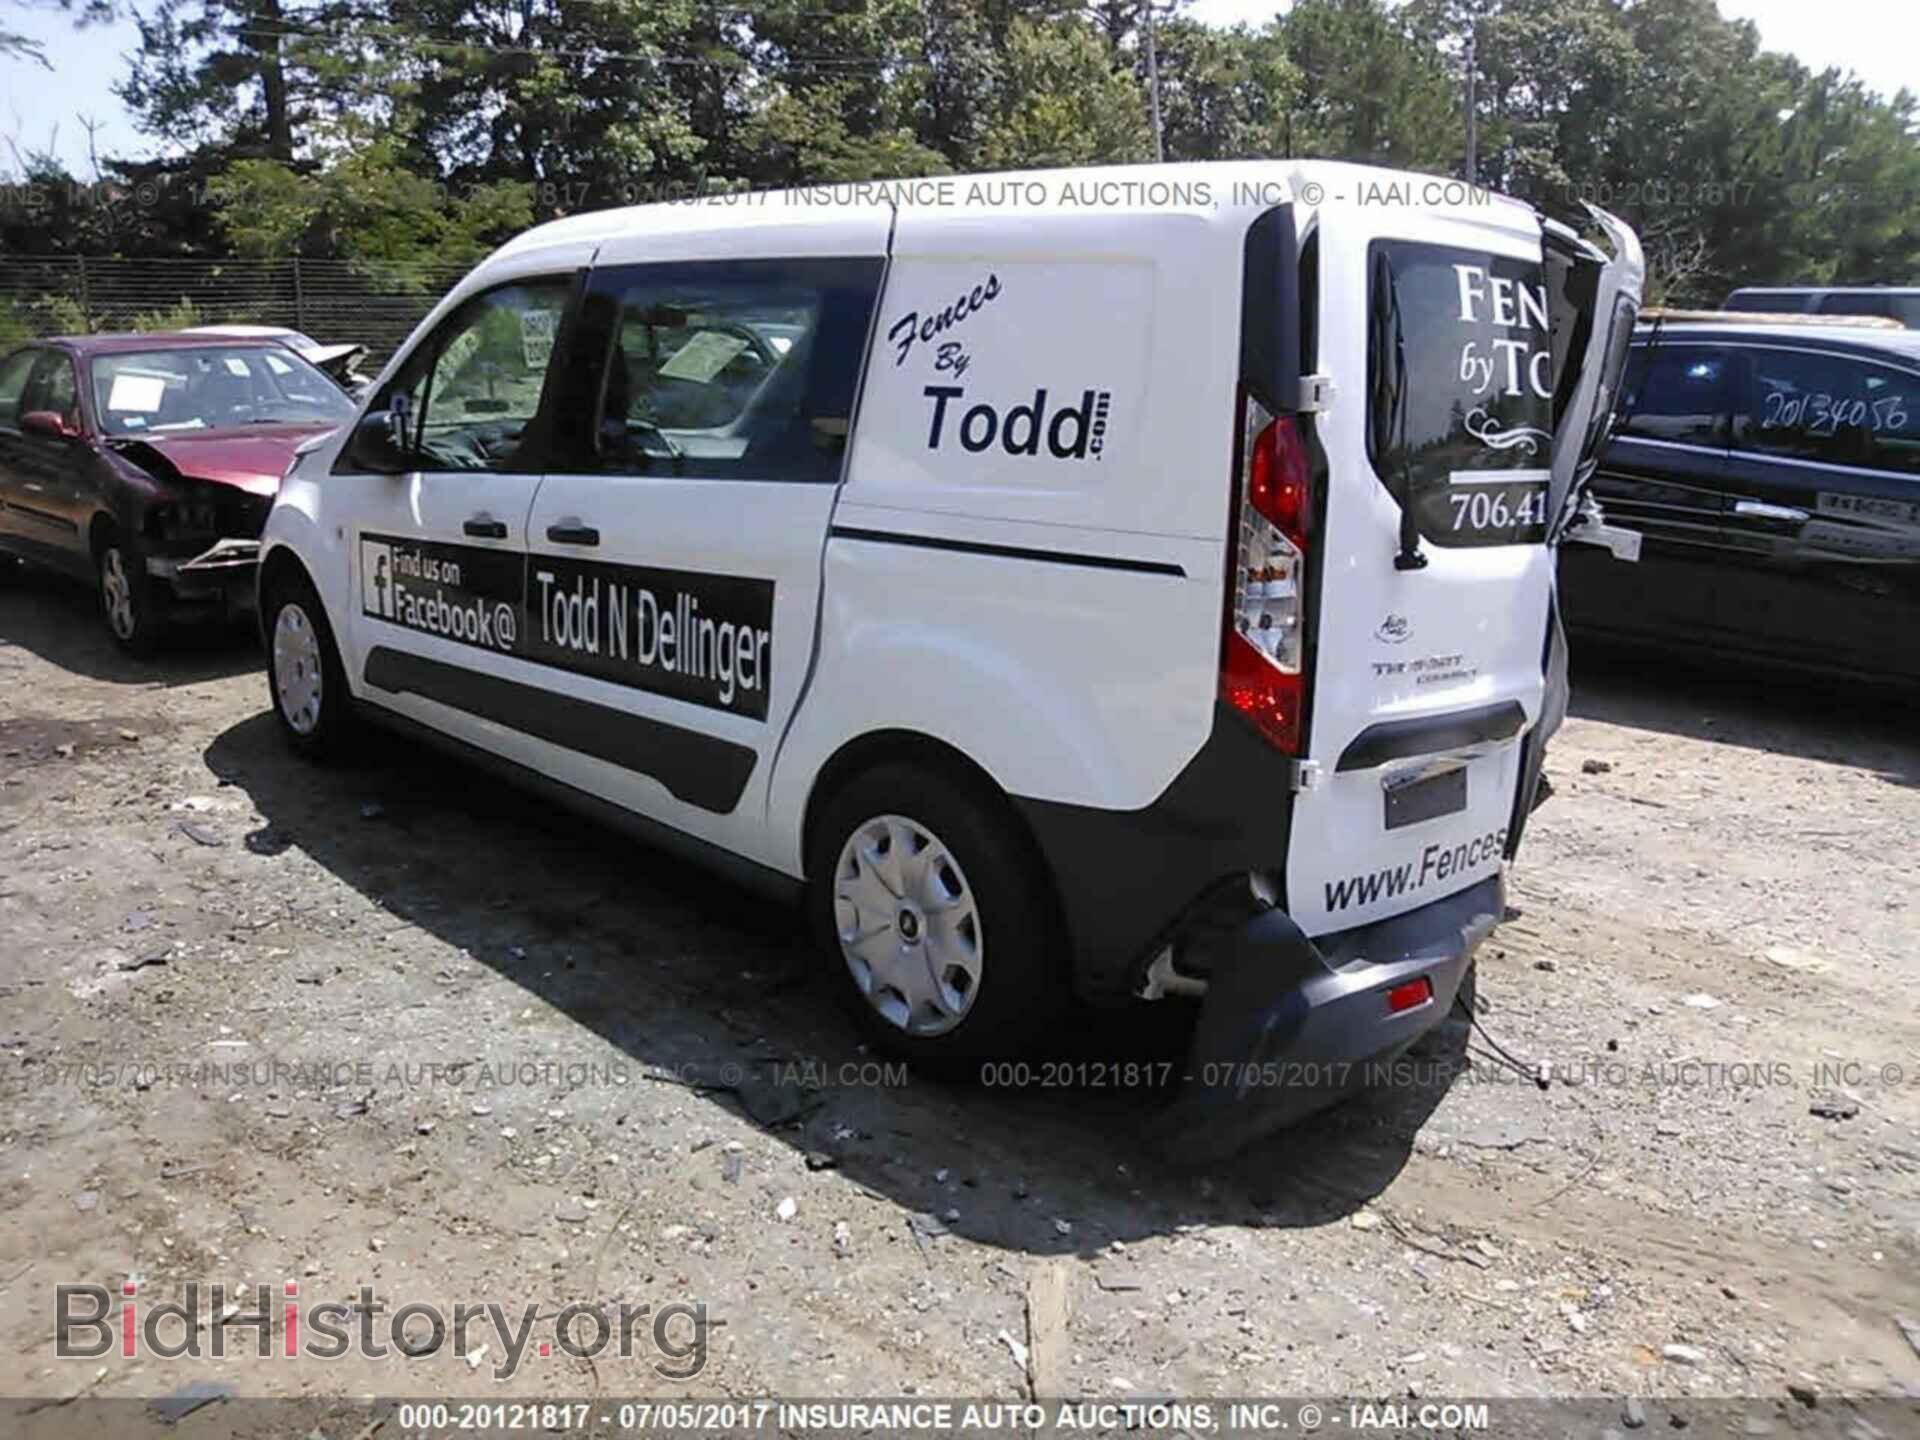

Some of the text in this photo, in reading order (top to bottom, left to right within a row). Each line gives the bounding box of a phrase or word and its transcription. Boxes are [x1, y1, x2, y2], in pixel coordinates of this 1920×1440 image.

[888, 273, 1001, 367] Fences
[935, 342, 970, 379] By
[923, 385, 1095, 459] Todd
[393, 547, 461, 586] Find us on
[537, 572, 770, 704] Todd N Dellinger
[1324, 828, 1508, 912] www.Fences
